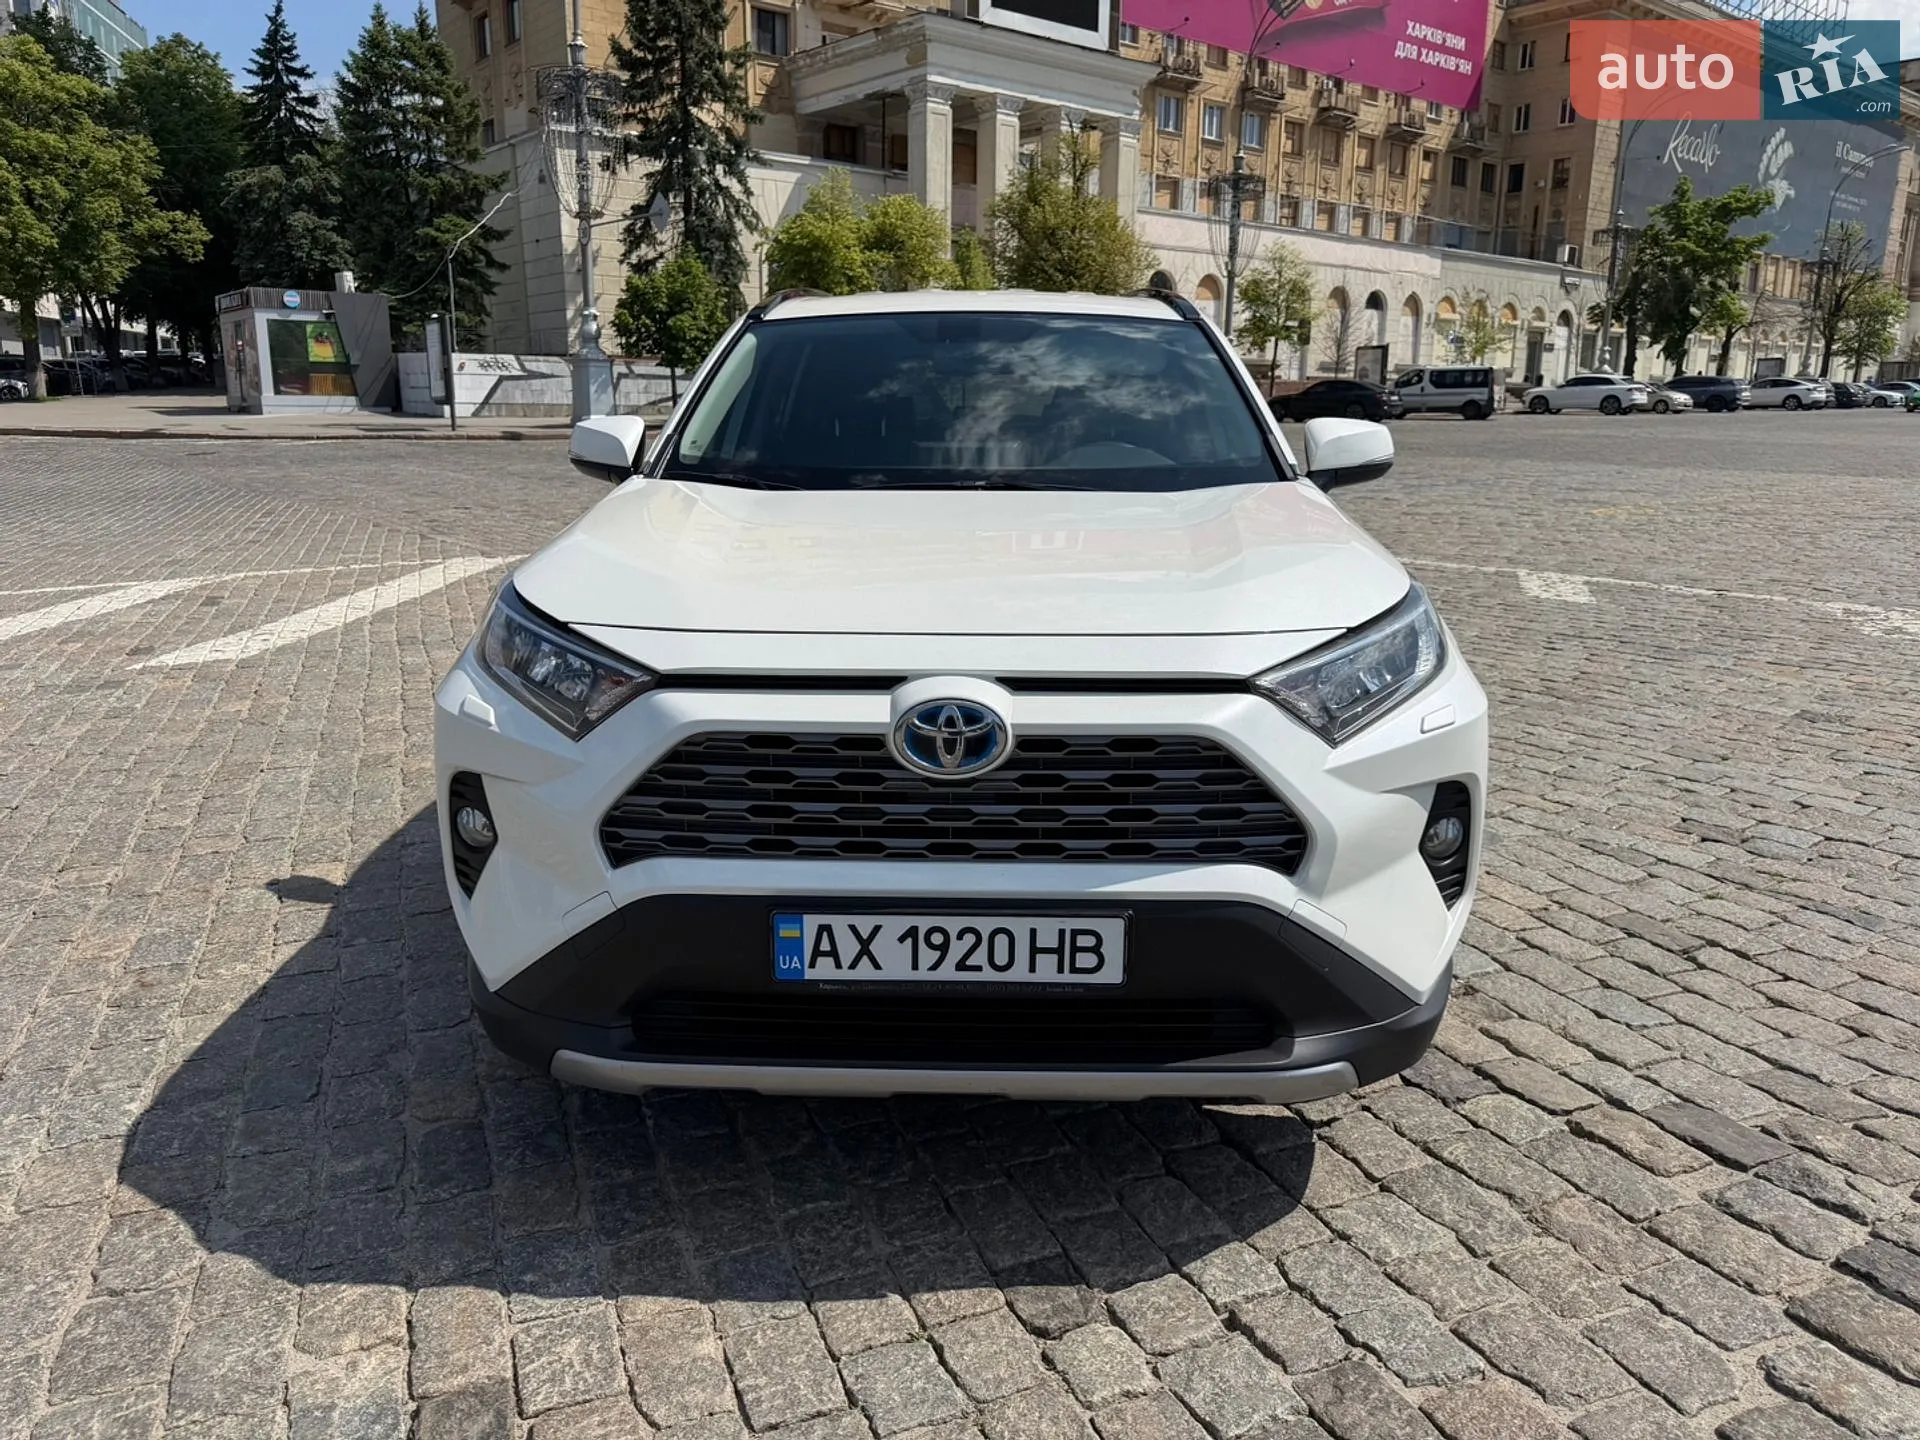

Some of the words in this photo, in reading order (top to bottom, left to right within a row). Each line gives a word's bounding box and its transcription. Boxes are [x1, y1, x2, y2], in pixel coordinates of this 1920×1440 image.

[1394, 40, 1418, 60] ДЛЯ
[808, 923, 883, 970] AX
[897, 925, 1016, 972] 1920
[1028, 927, 1105, 975] HB
[780, 955, 801, 969] UA
